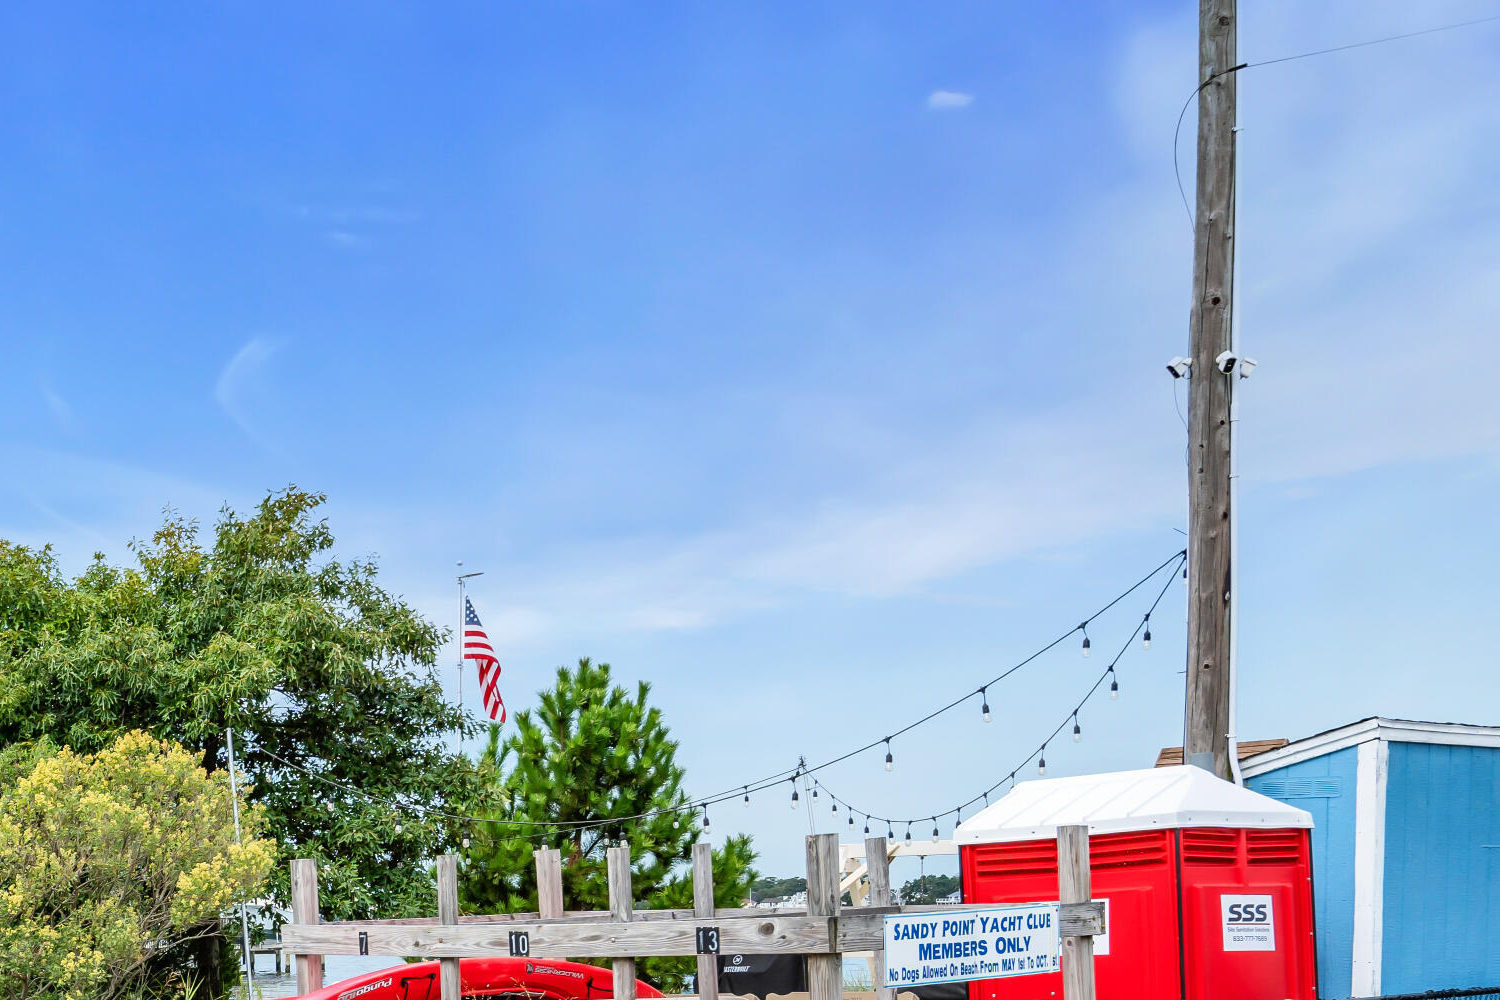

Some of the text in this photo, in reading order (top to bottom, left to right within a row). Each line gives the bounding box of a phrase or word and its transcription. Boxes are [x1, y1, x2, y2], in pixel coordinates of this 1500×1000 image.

[1228, 904, 1267, 922] SSS
[894, 922, 937, 941] SANDY
[942, 919, 975, 937] POINT
[980, 915, 1023, 933] YACHT
[359, 935, 366, 952] 7
[511, 935, 528, 953] 10
[699, 931, 718, 950] 13
[918, 936, 1031, 961] MEMBERS ONLY
[889, 968, 898, 981] No
[902, 967, 919, 982] Dogs
[923, 964, 947, 979] Allowed
[950, 963, 958, 976] On
[961, 962, 978, 975] Beach
[980, 960, 999, 973] From
[1002, 958, 1015, 971] MAY
[1027, 956, 1034, 968] To
[1036, 955, 1048, 968] OCT.
